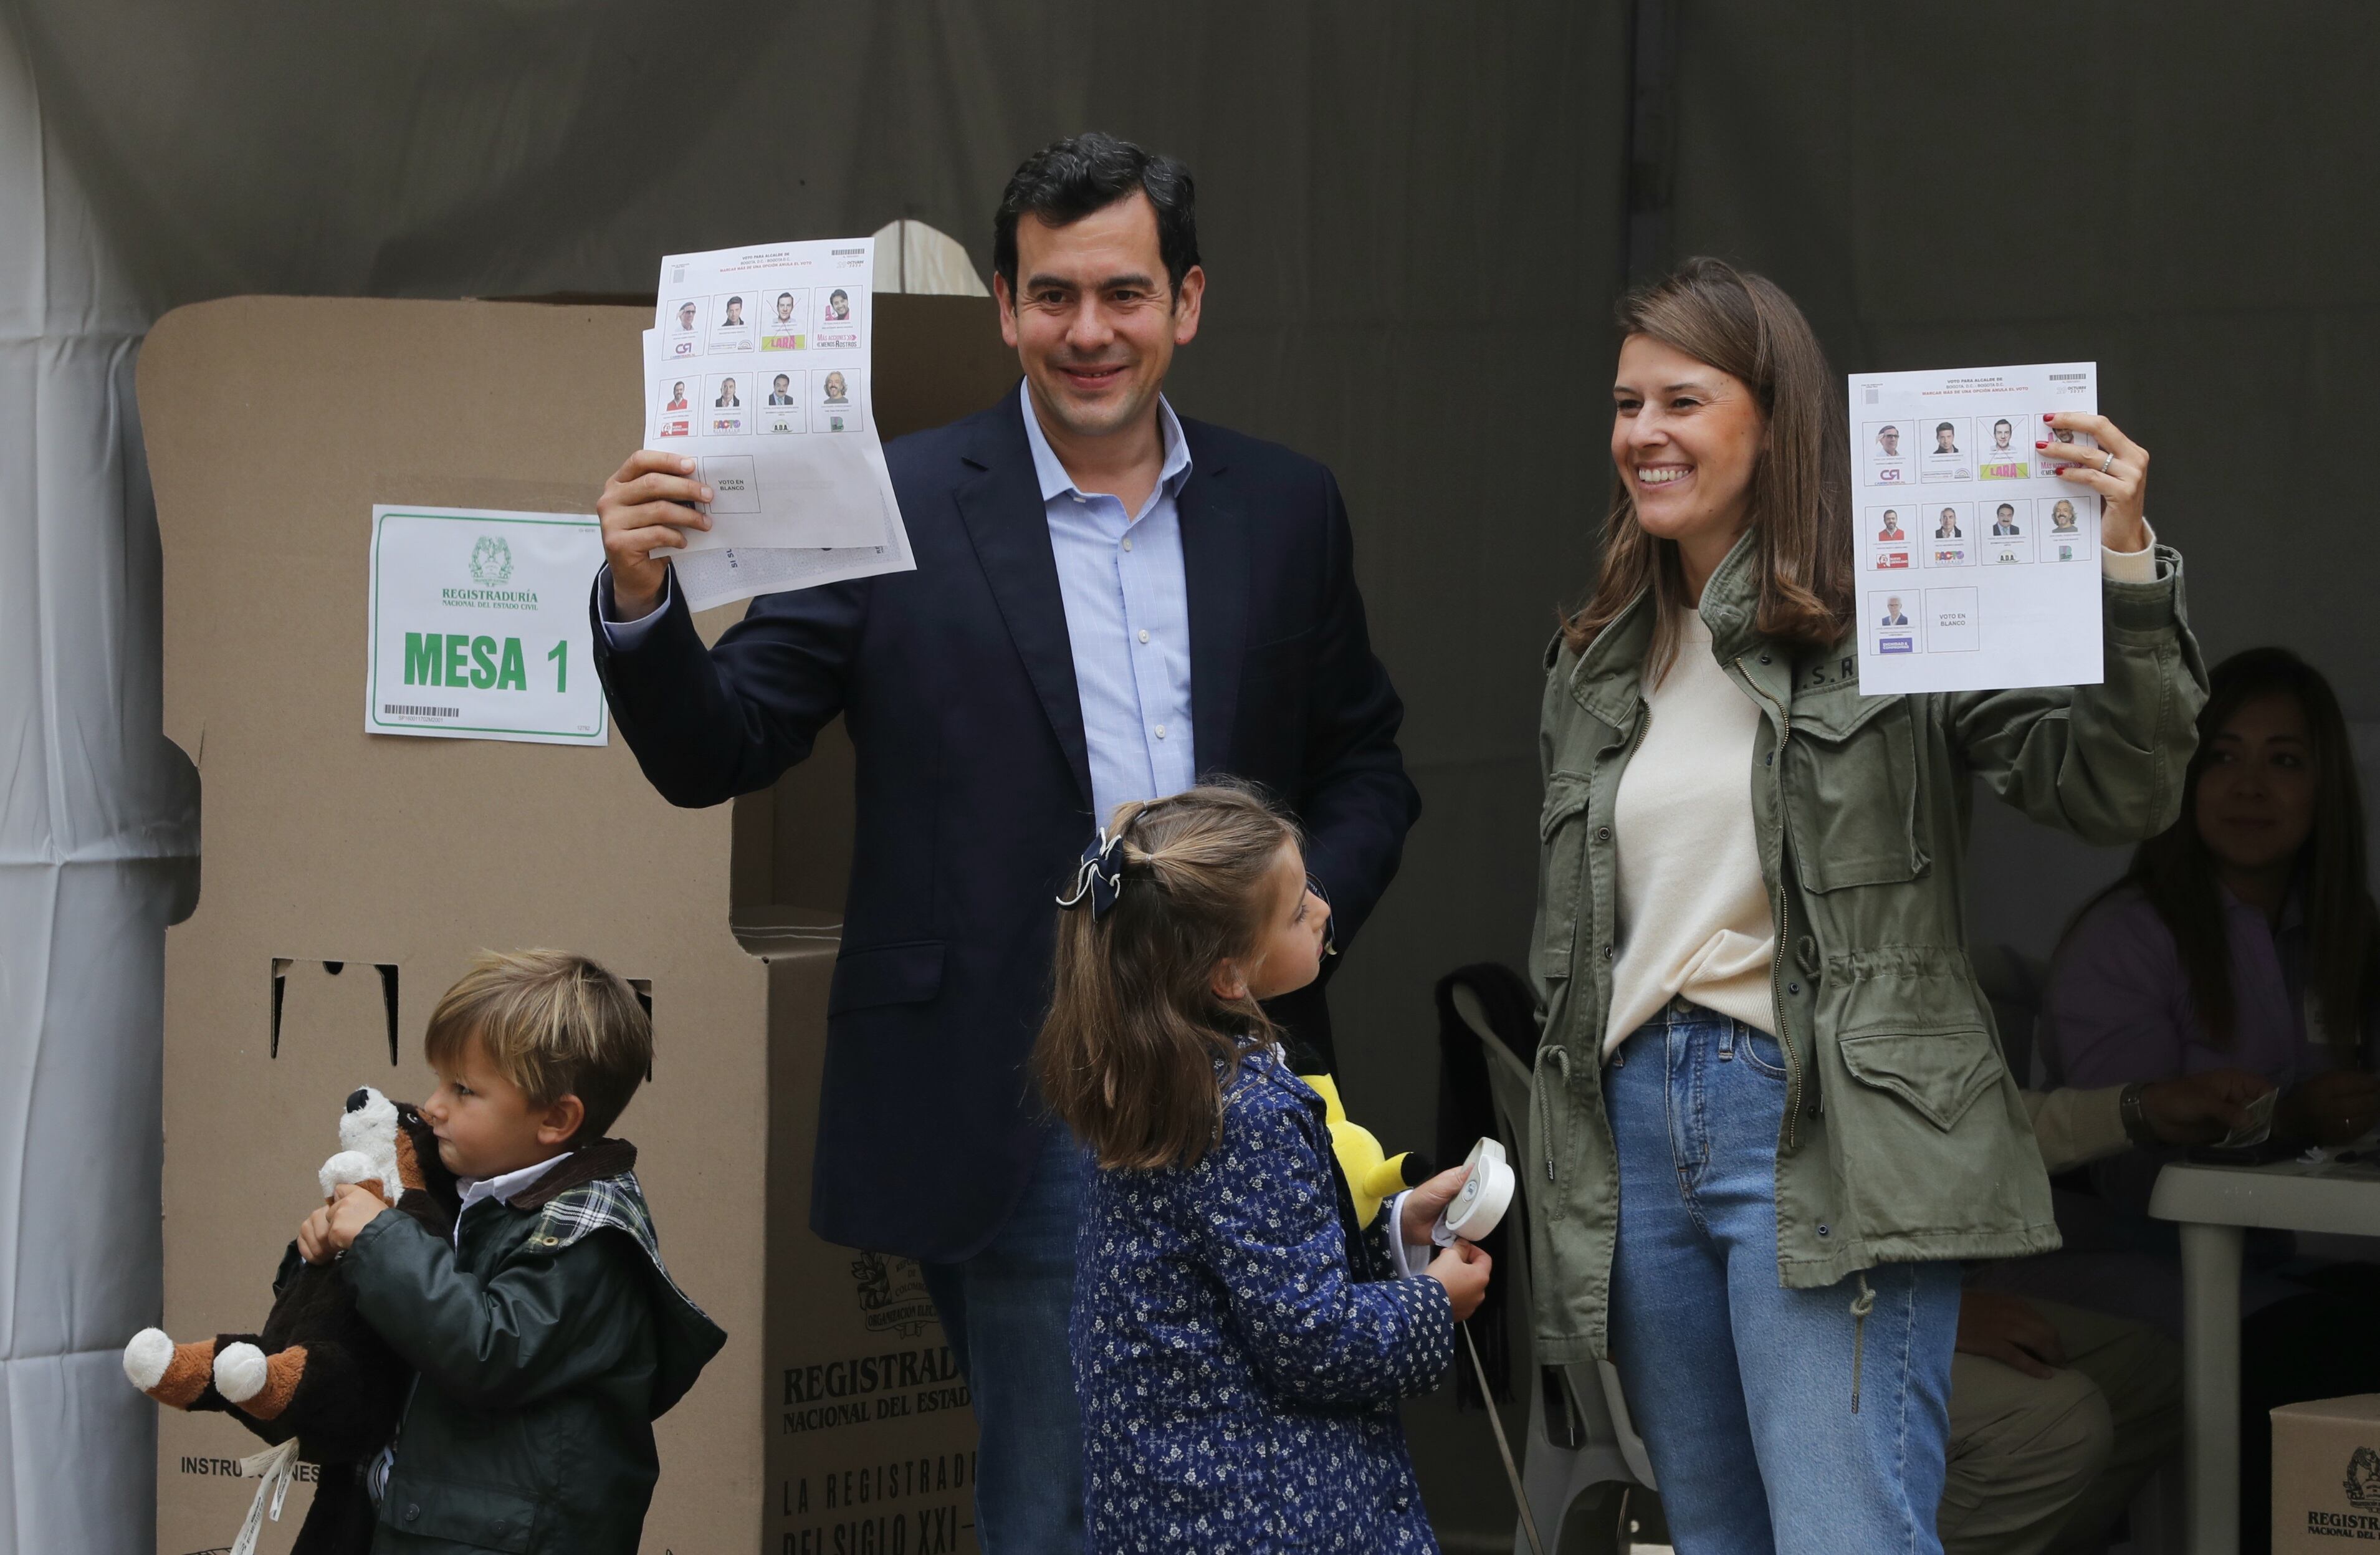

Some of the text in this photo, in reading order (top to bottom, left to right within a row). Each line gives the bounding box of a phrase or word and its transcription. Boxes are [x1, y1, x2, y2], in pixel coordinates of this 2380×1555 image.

[770, 335, 795, 349] LARA
[714, 419, 741, 429] PACTO
[1990, 463, 2017, 478] LARA
[1935, 550, 1964, 561] PACTO
[442, 588, 538, 603] REGISTRADURÍA
[404, 632, 568, 693] MESA 1
[868, 1302, 915, 1327] ORGANIZACIÓN
[783, 1346, 960, 1405] REGISTRAD
[783, 1386, 972, 1435] NACIONAL DEL ESTAD
[783, 1451, 976, 1516] LA REGISTRAD
[918, 1506, 957, 1555] XXI
[2308, 1511, 2380, 1531] REGISTR
[2308, 1526, 2354, 1538] NACIONAL
[2357, 1530, 2376, 1539] DEL
